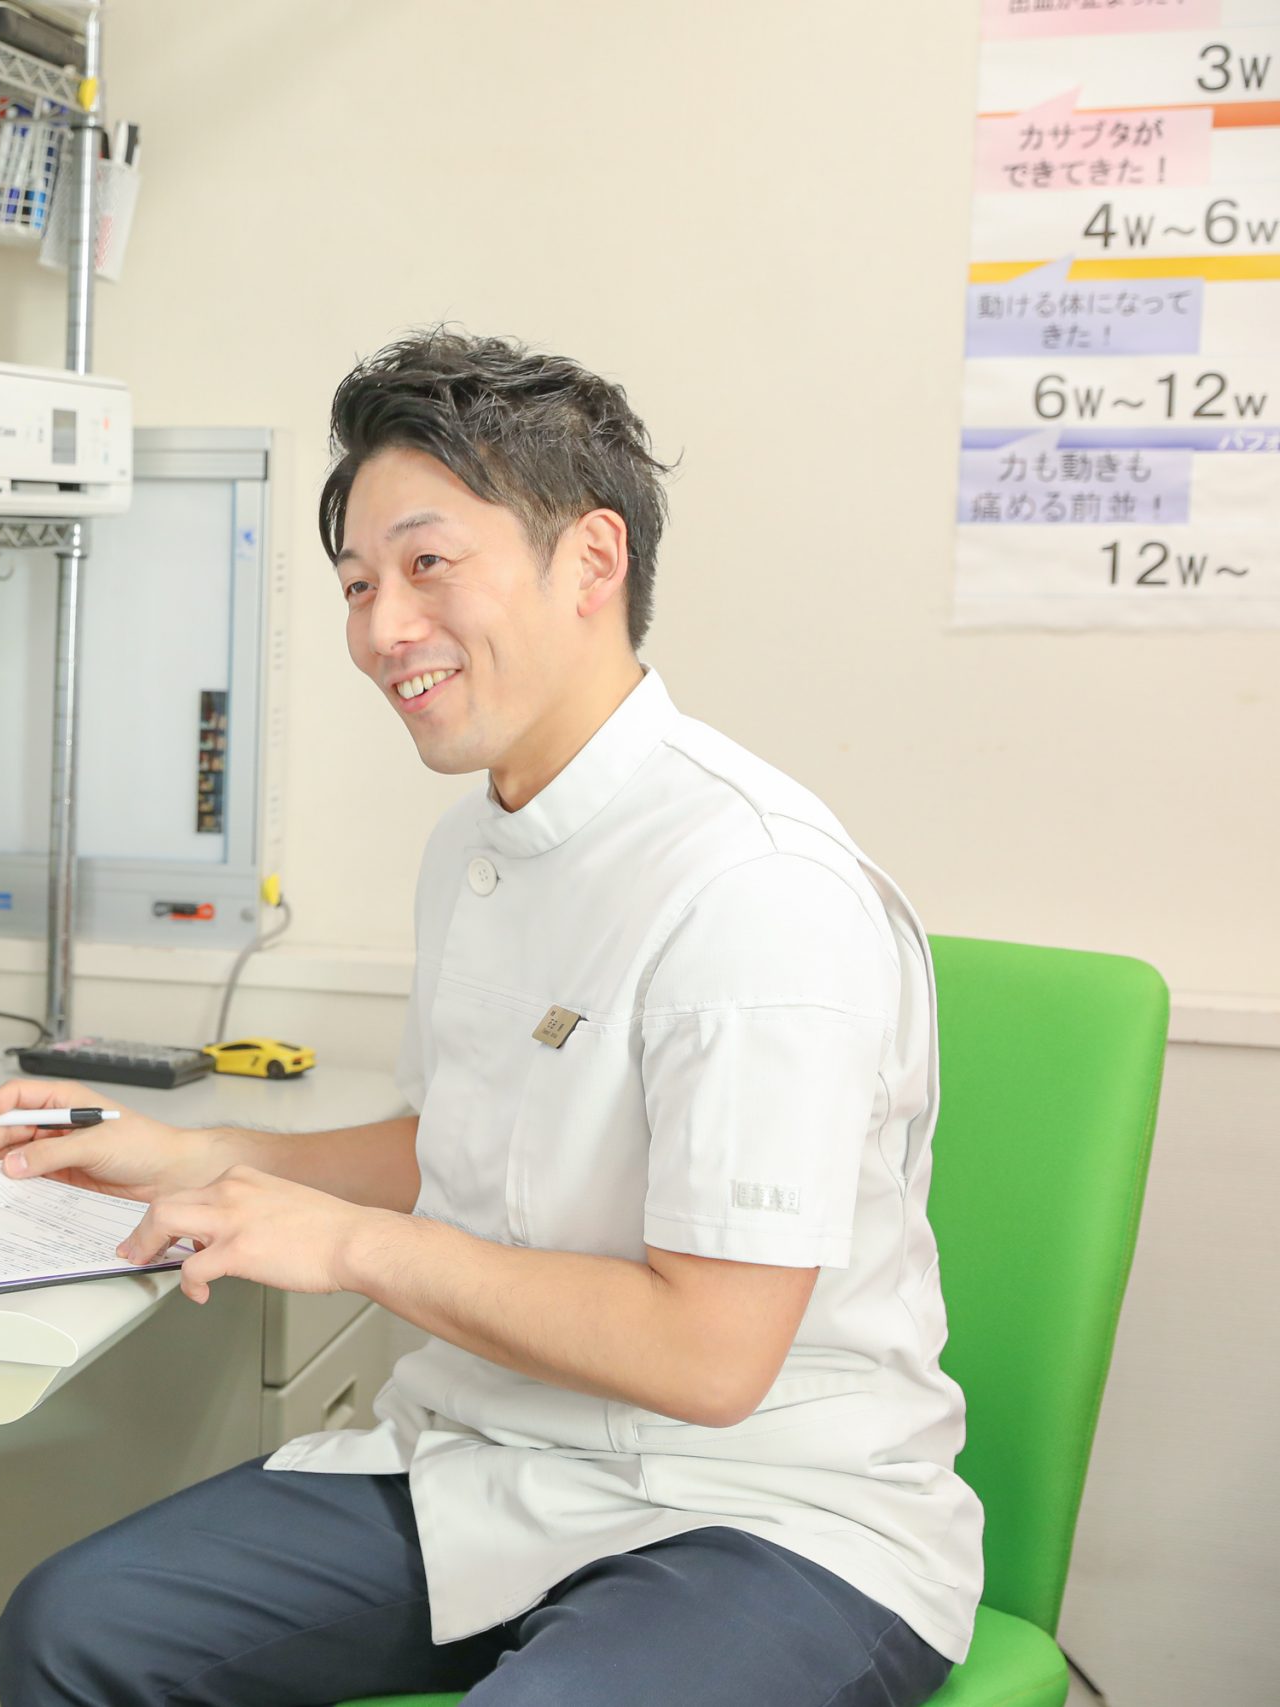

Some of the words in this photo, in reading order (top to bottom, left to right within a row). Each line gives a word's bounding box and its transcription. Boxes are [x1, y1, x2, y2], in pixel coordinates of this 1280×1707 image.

[1019, 118, 1165, 151] カサブタが
[1003, 156, 1167, 188] できてきた！
[977, 289, 1193, 320] 動ける体になって
[1041, 322, 1112, 350] きた！
[997, 450, 1152, 484] 力も動きも
